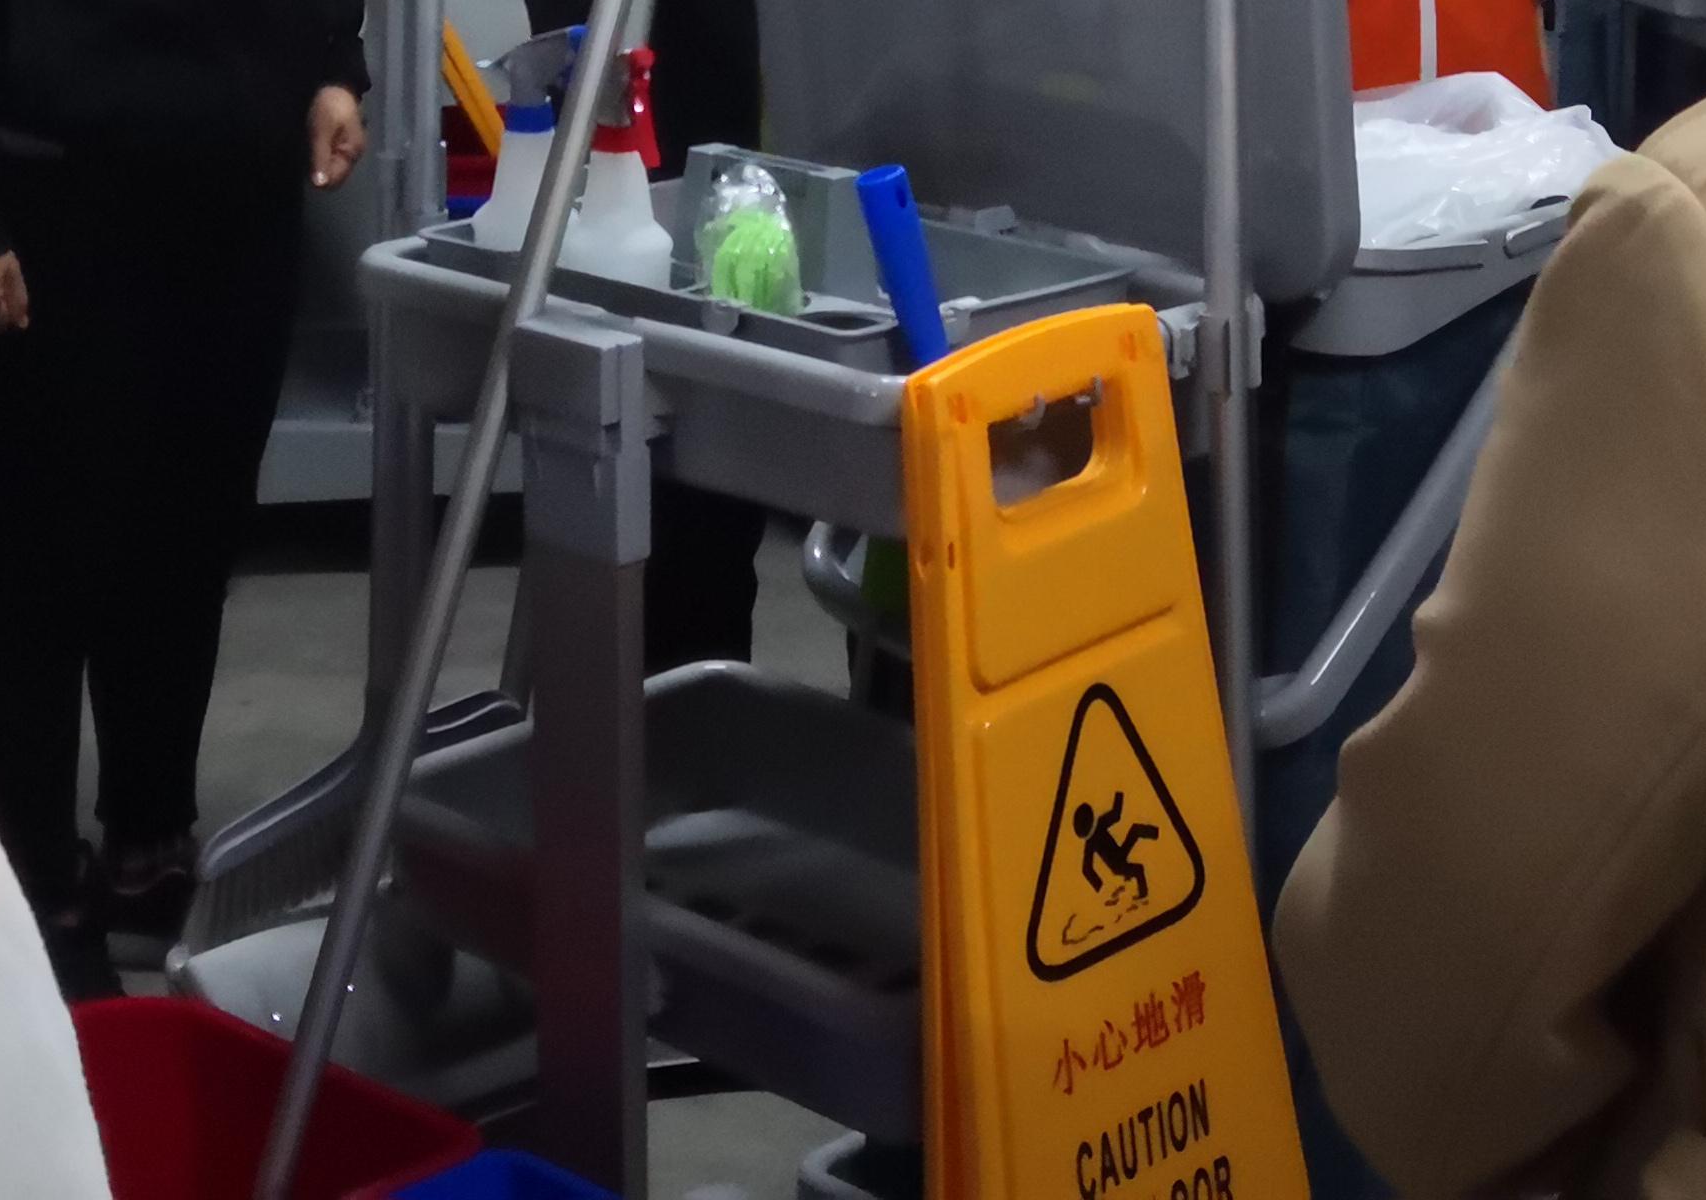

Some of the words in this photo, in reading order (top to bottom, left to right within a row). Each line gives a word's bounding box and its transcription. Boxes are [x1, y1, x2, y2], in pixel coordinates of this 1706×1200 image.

[1052, 969, 1207, 1096] 小心地滑
[1076, 1078, 1211, 1200] CAUTION
